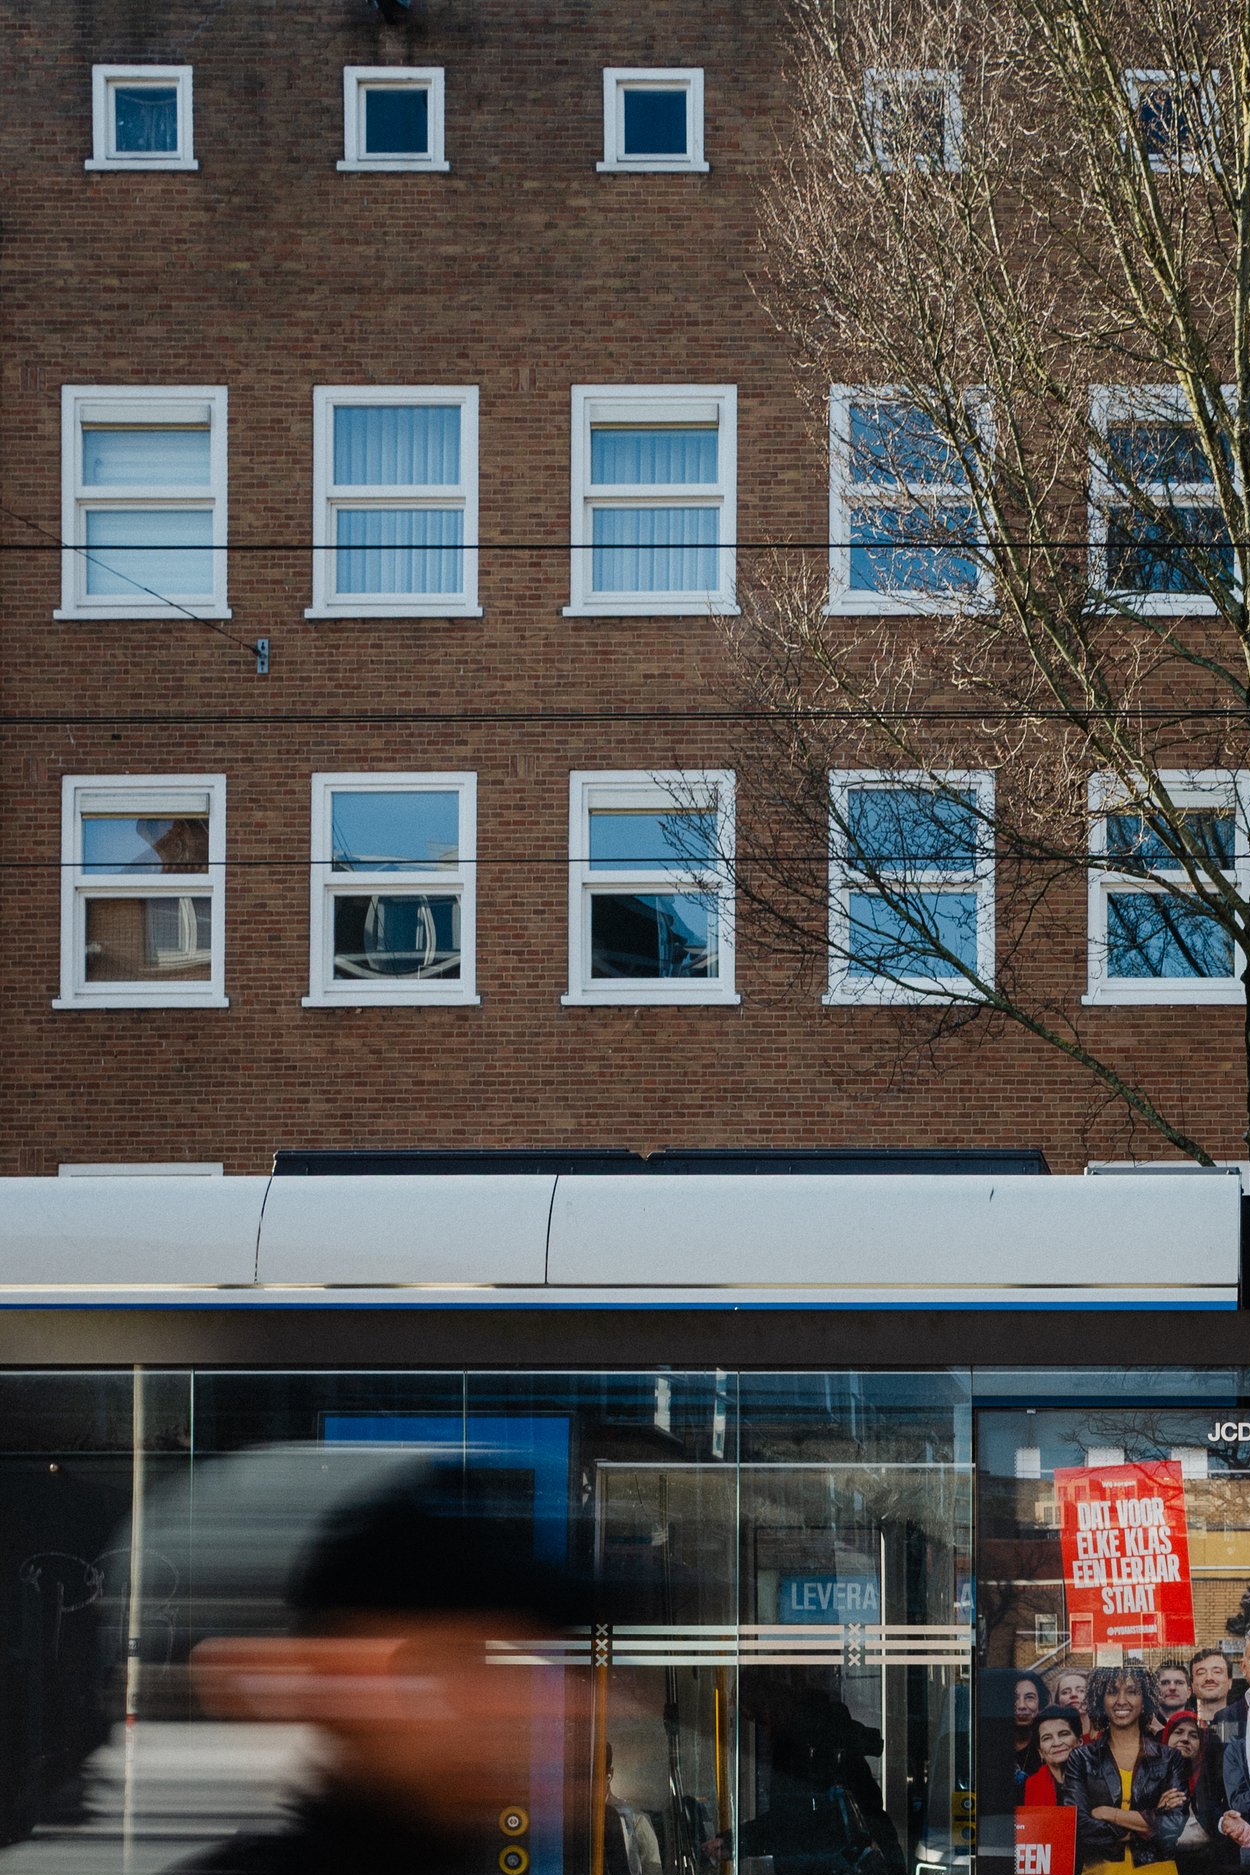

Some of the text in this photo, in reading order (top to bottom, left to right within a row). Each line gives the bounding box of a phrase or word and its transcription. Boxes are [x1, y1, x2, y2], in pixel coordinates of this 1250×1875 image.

[1077, 1497, 1166, 1531] DAT VOOR
[1076, 1526, 1172, 1560] ELKE KLAS
[1072, 1554, 1181, 1589] EEN LERAAR
[790, 1582, 878, 1610] LEVERA
[1101, 1584, 1155, 1615] STAAT
[1016, 1844, 1051, 1875] EEN
